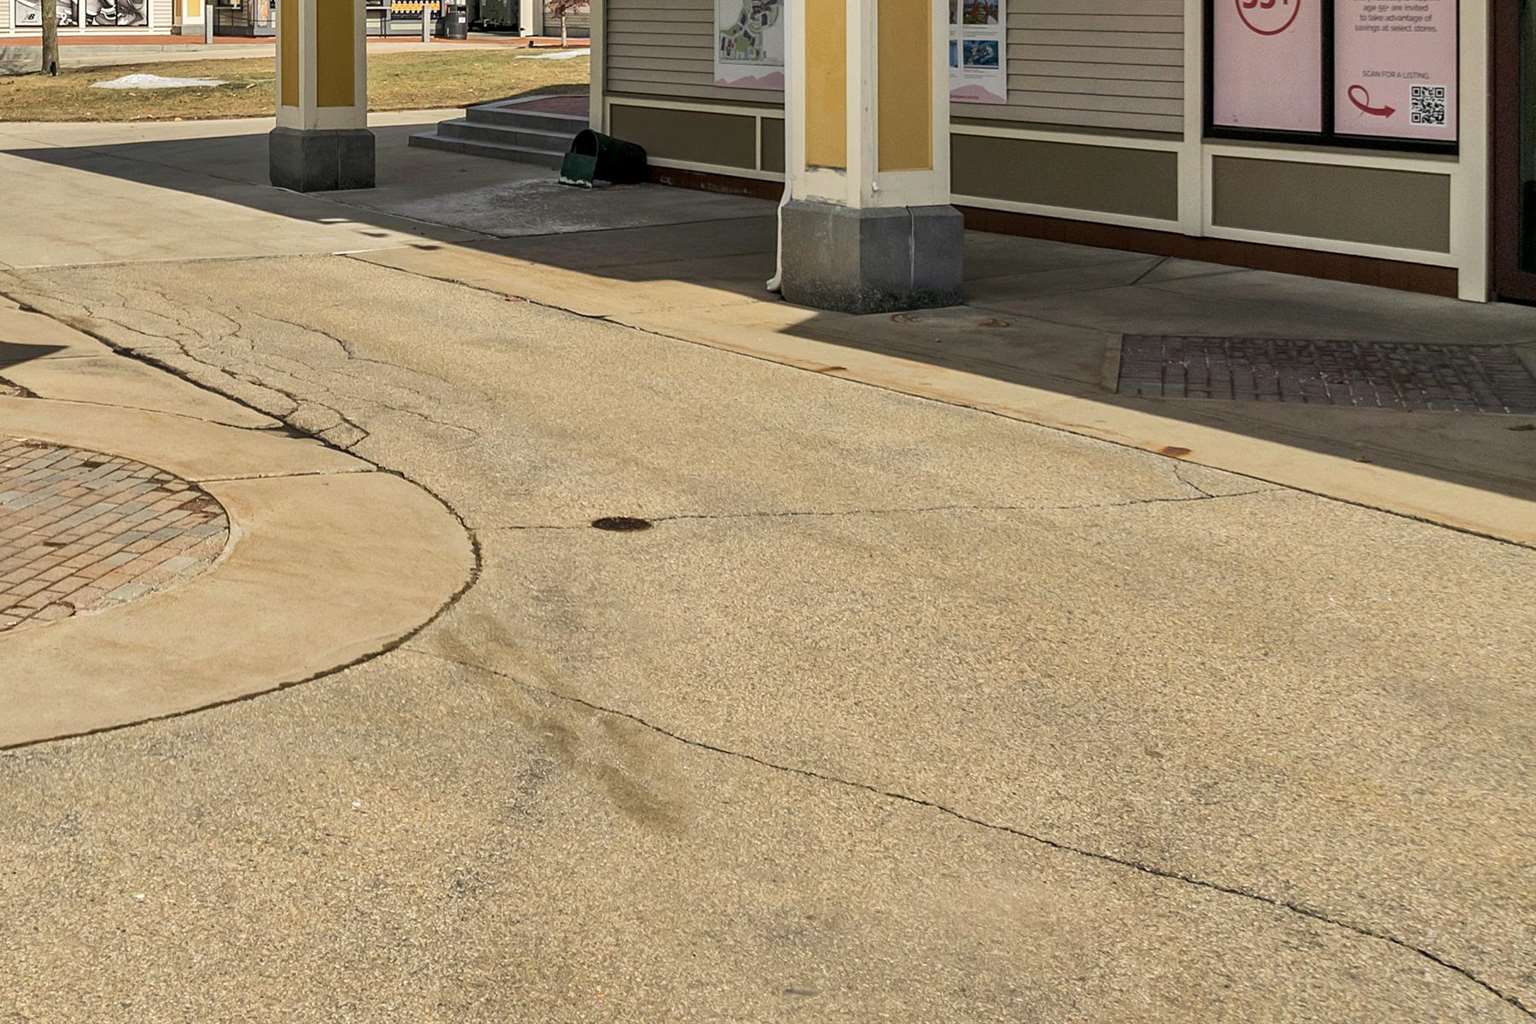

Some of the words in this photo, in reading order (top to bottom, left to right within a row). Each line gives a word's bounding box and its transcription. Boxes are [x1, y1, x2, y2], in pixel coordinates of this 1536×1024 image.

[1404, 4, 1429, 12] invited
[1360, 14, 1368, 22] to
[1368, 14, 1384, 22] take
[1384, 14, 1423, 23] advantage
[1424, 14, 1432, 22] of
[1361, 70, 1380, 78] SCAN
[1381, 70, 1396, 78] FOR
[1402, 71, 1430, 80] LISTING
